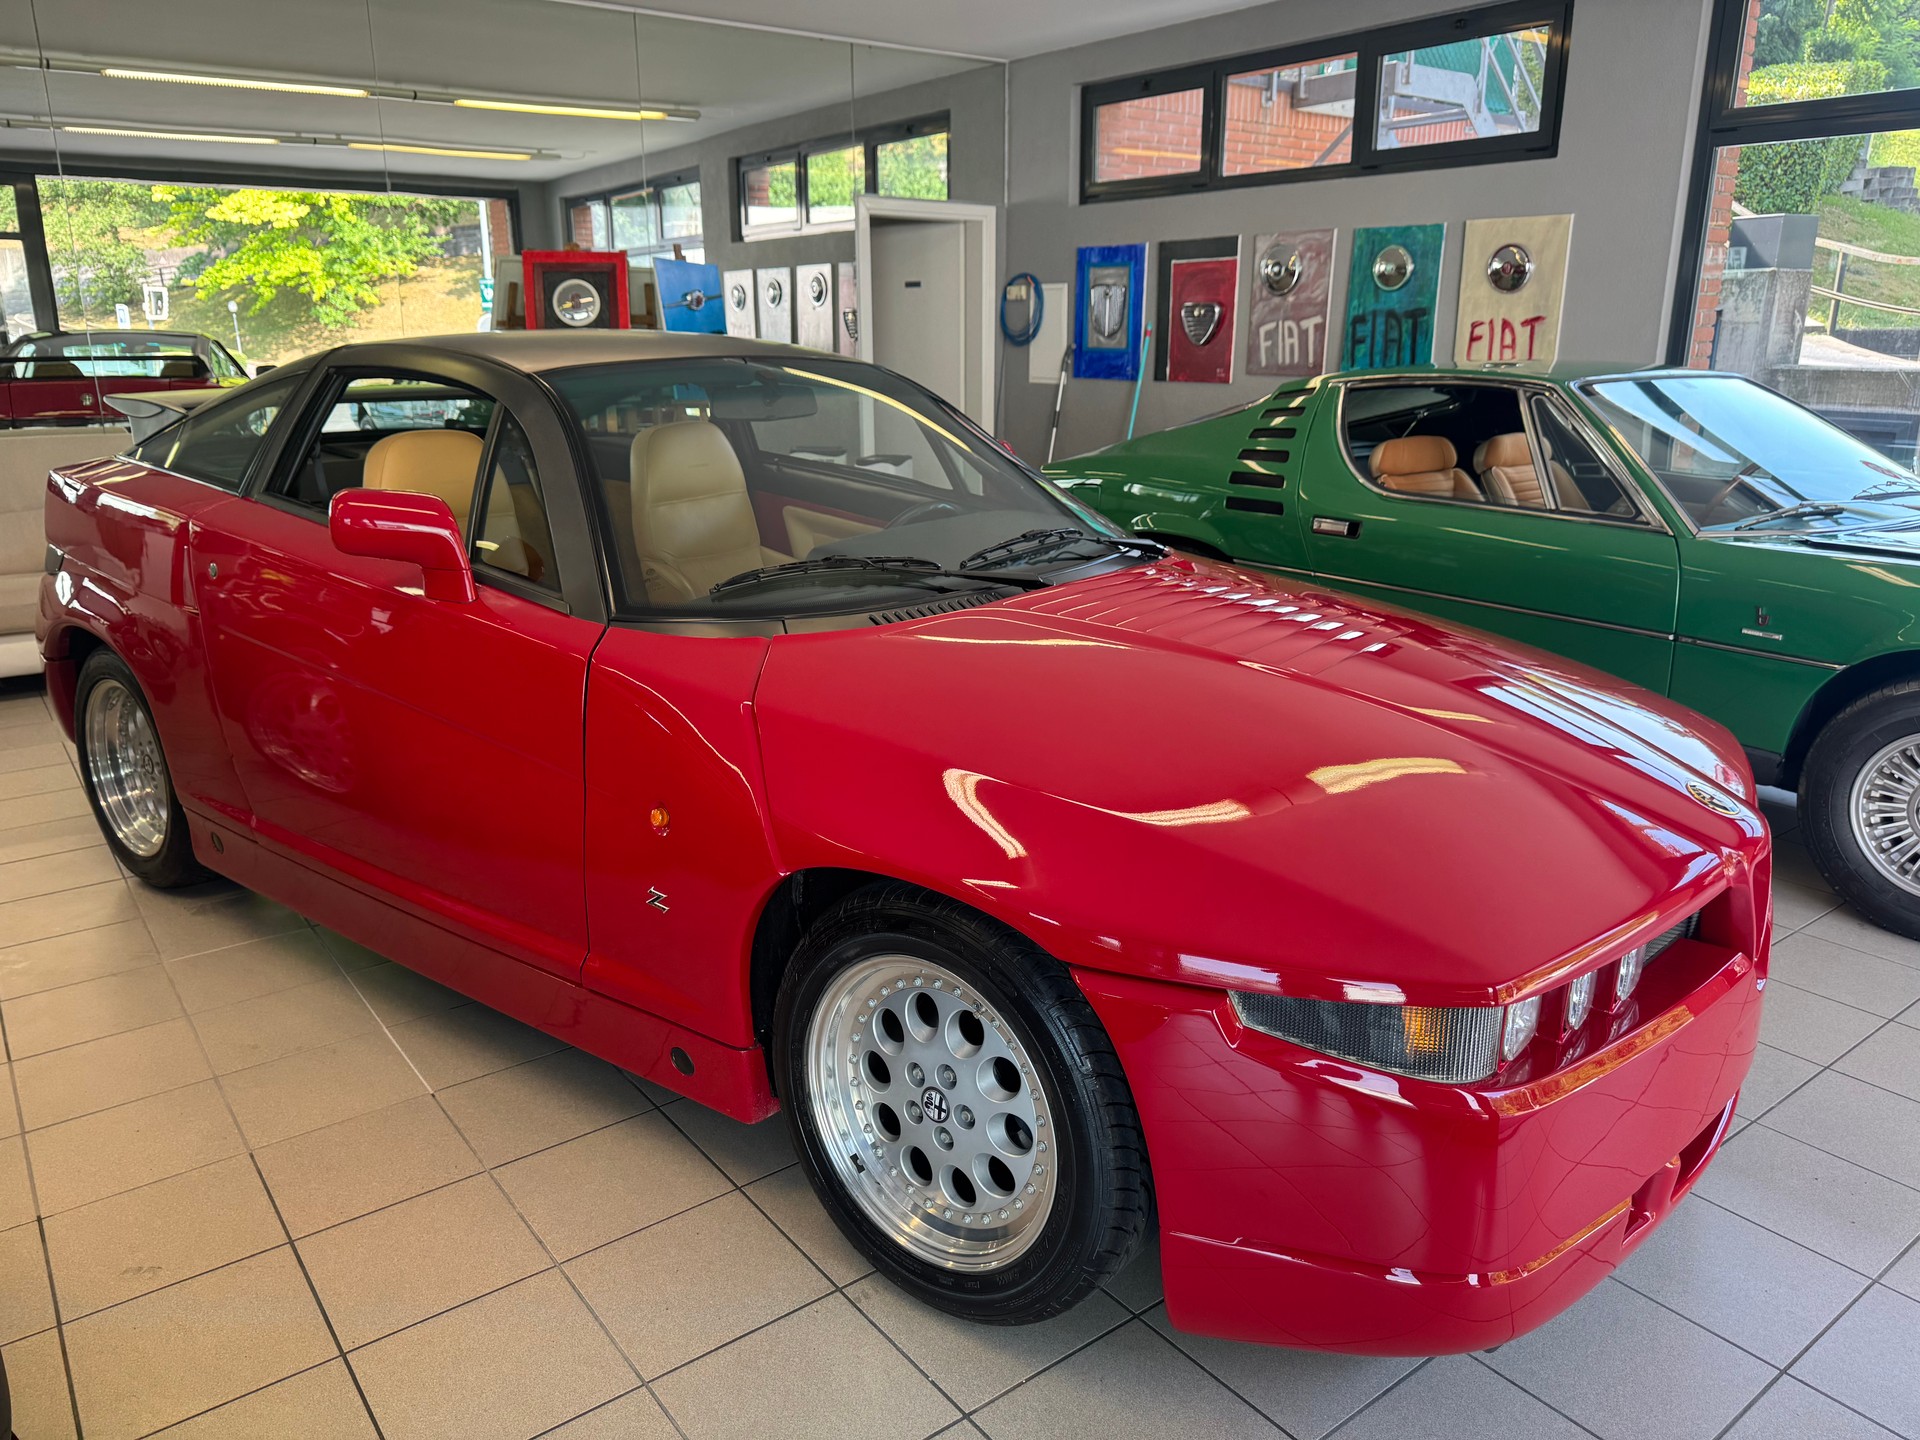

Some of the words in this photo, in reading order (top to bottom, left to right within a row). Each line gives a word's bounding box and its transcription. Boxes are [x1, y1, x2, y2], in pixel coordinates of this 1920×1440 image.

[1259, 315, 1323, 368] FIAT
[1351, 307, 1427, 368] FIAT
[1466, 315, 1546, 361] FIAT
